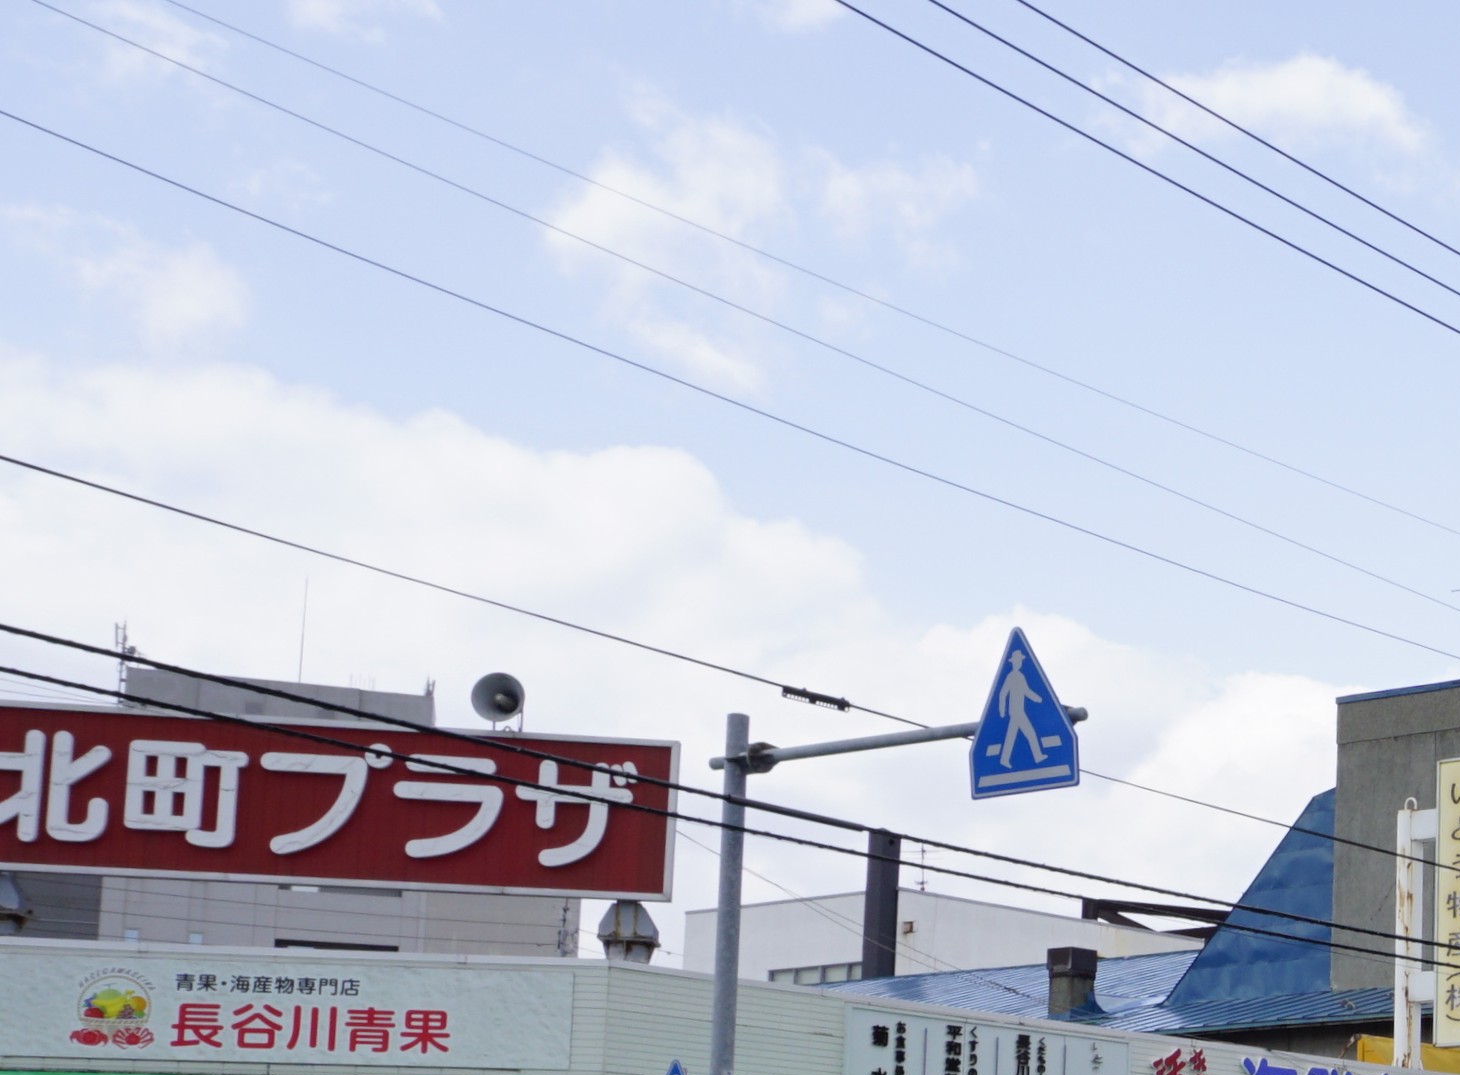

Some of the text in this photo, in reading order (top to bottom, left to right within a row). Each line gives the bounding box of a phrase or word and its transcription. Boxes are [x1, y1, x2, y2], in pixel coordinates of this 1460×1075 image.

[0, 729, 637, 867] 北町プラザ
[175, 973, 361, 996] 青果・海産物専門店
[170, 1003, 450, 1054] 長谷川青果
